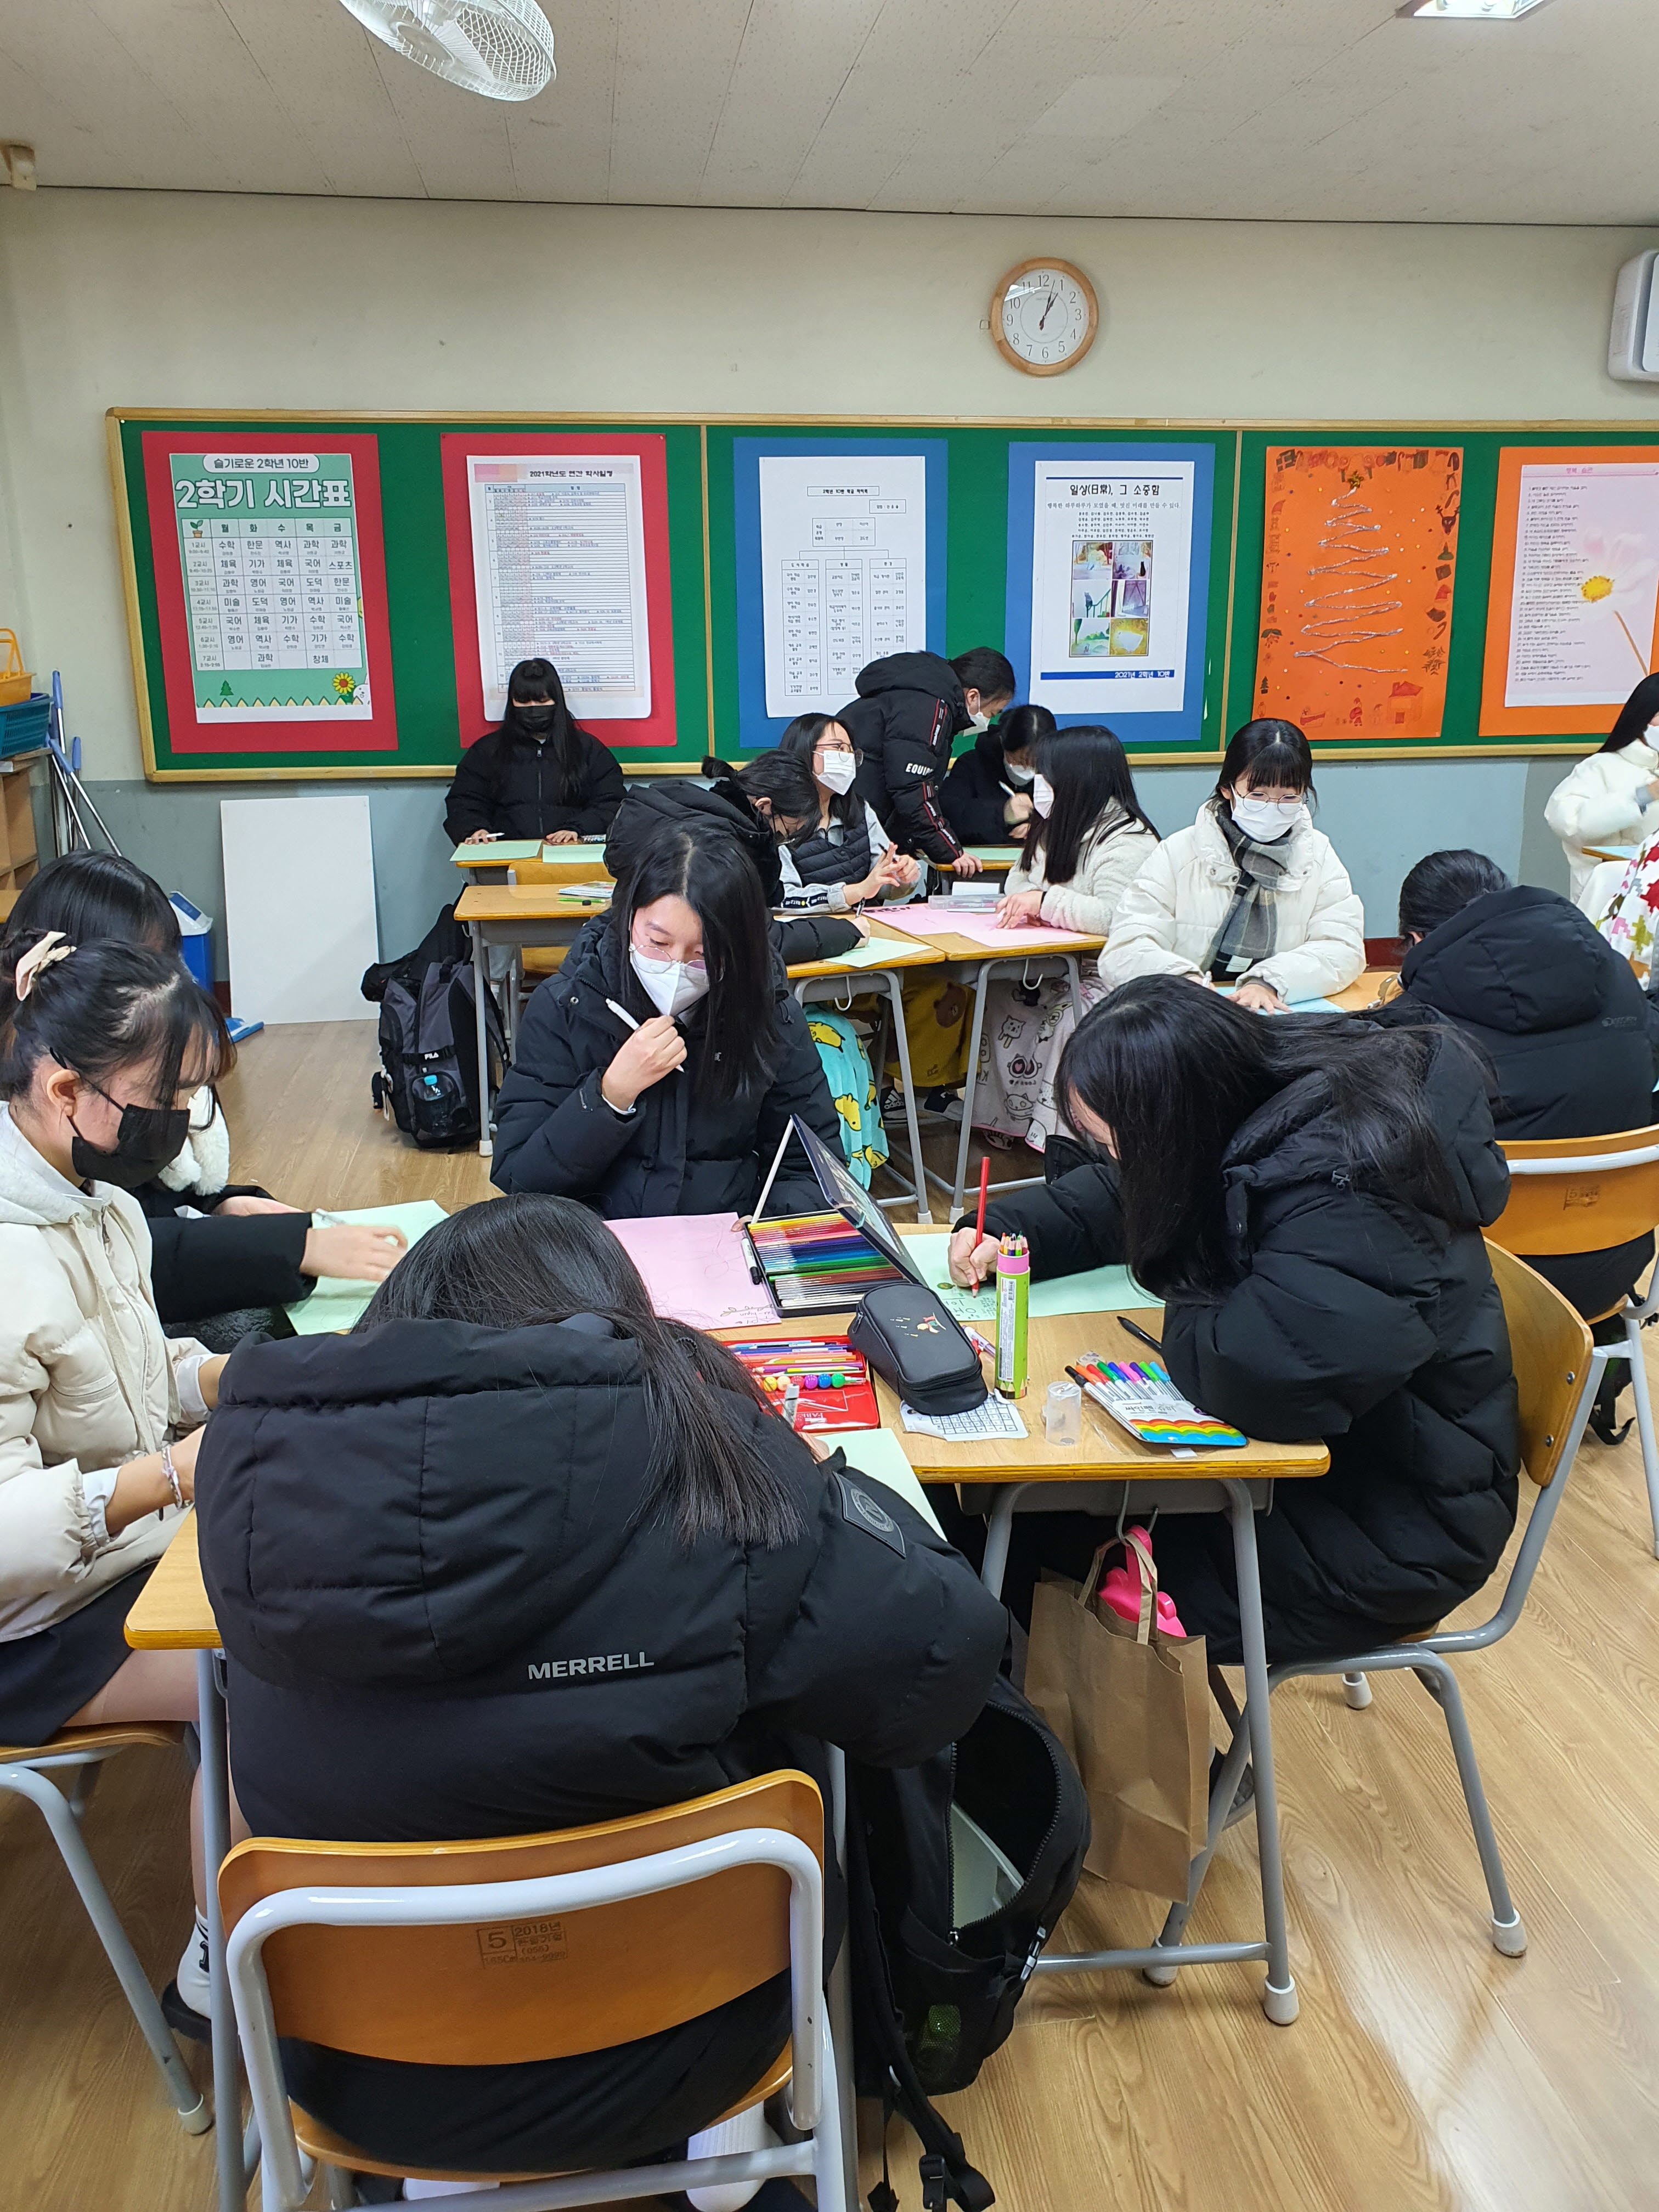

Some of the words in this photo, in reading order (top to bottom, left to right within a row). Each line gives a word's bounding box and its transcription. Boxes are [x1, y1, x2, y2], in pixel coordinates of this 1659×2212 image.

[1038, 274, 1049, 287] 12
[1060, 280, 1063, 291] 1
[1070, 292, 1076, 303] 2
[1009, 297, 1020, 309] 10
[1075, 309, 1082, 320] 3
[1007, 314, 1013, 326] 9
[1013, 333, 1019, 345] 8
[1070, 329, 1076, 340] 4
[1027, 345, 1032, 357] 7
[1059, 341, 1065, 352] 5
[1042, 347, 1049, 359] 6
[214, 459, 254, 469] 슬기로운
[257, 459, 284, 469] 2학년
[286, 459, 308, 469] 10반
[176, 479, 255, 509] 2학기
[264, 479, 352, 509] 시간표
[1120, 485, 1127, 495] 그
[1133, 485, 1160, 495] 소중함
[222, 524, 229, 533] 월
[250, 524, 257, 532] 화
[278, 523, 285, 532] 수
[306, 523, 314, 532] 목
[334, 523, 341, 532] 금
[219, 541, 235, 550] 수학
[247, 540, 263, 549] 한문
[275, 540, 291, 549] 역사
[304, 540, 319, 549] 과학
[331, 540, 347, 549] 과학
[221, 560, 236, 568] 체육
[249, 560, 264, 568] 기가
[277, 559, 292, 567] 체육
[305, 559, 320, 567] 국어
[329, 561, 352, 569] 스포츠
[250, 578, 267, 587] 영어
[279, 578, 294, 586] 국어
[334, 578, 349, 586] 한문
[224, 598, 239, 606] 미술
[280, 597, 296, 606] 영어
[226, 617, 241, 625] 국어
[255, 616, 270, 624] 체육
[282, 616, 297, 624] 기가
[309, 616, 325, 624] 수학
[337, 615, 353, 623] 국어
[228, 635, 244, 644] 영어
[284, 634, 299, 643] 수학
[312, 634, 327, 642] 기가
[313, 655, 329, 664] 창체
[528, 1651, 654, 1680] MERRELL
[488, 1931, 507, 1949] 5
